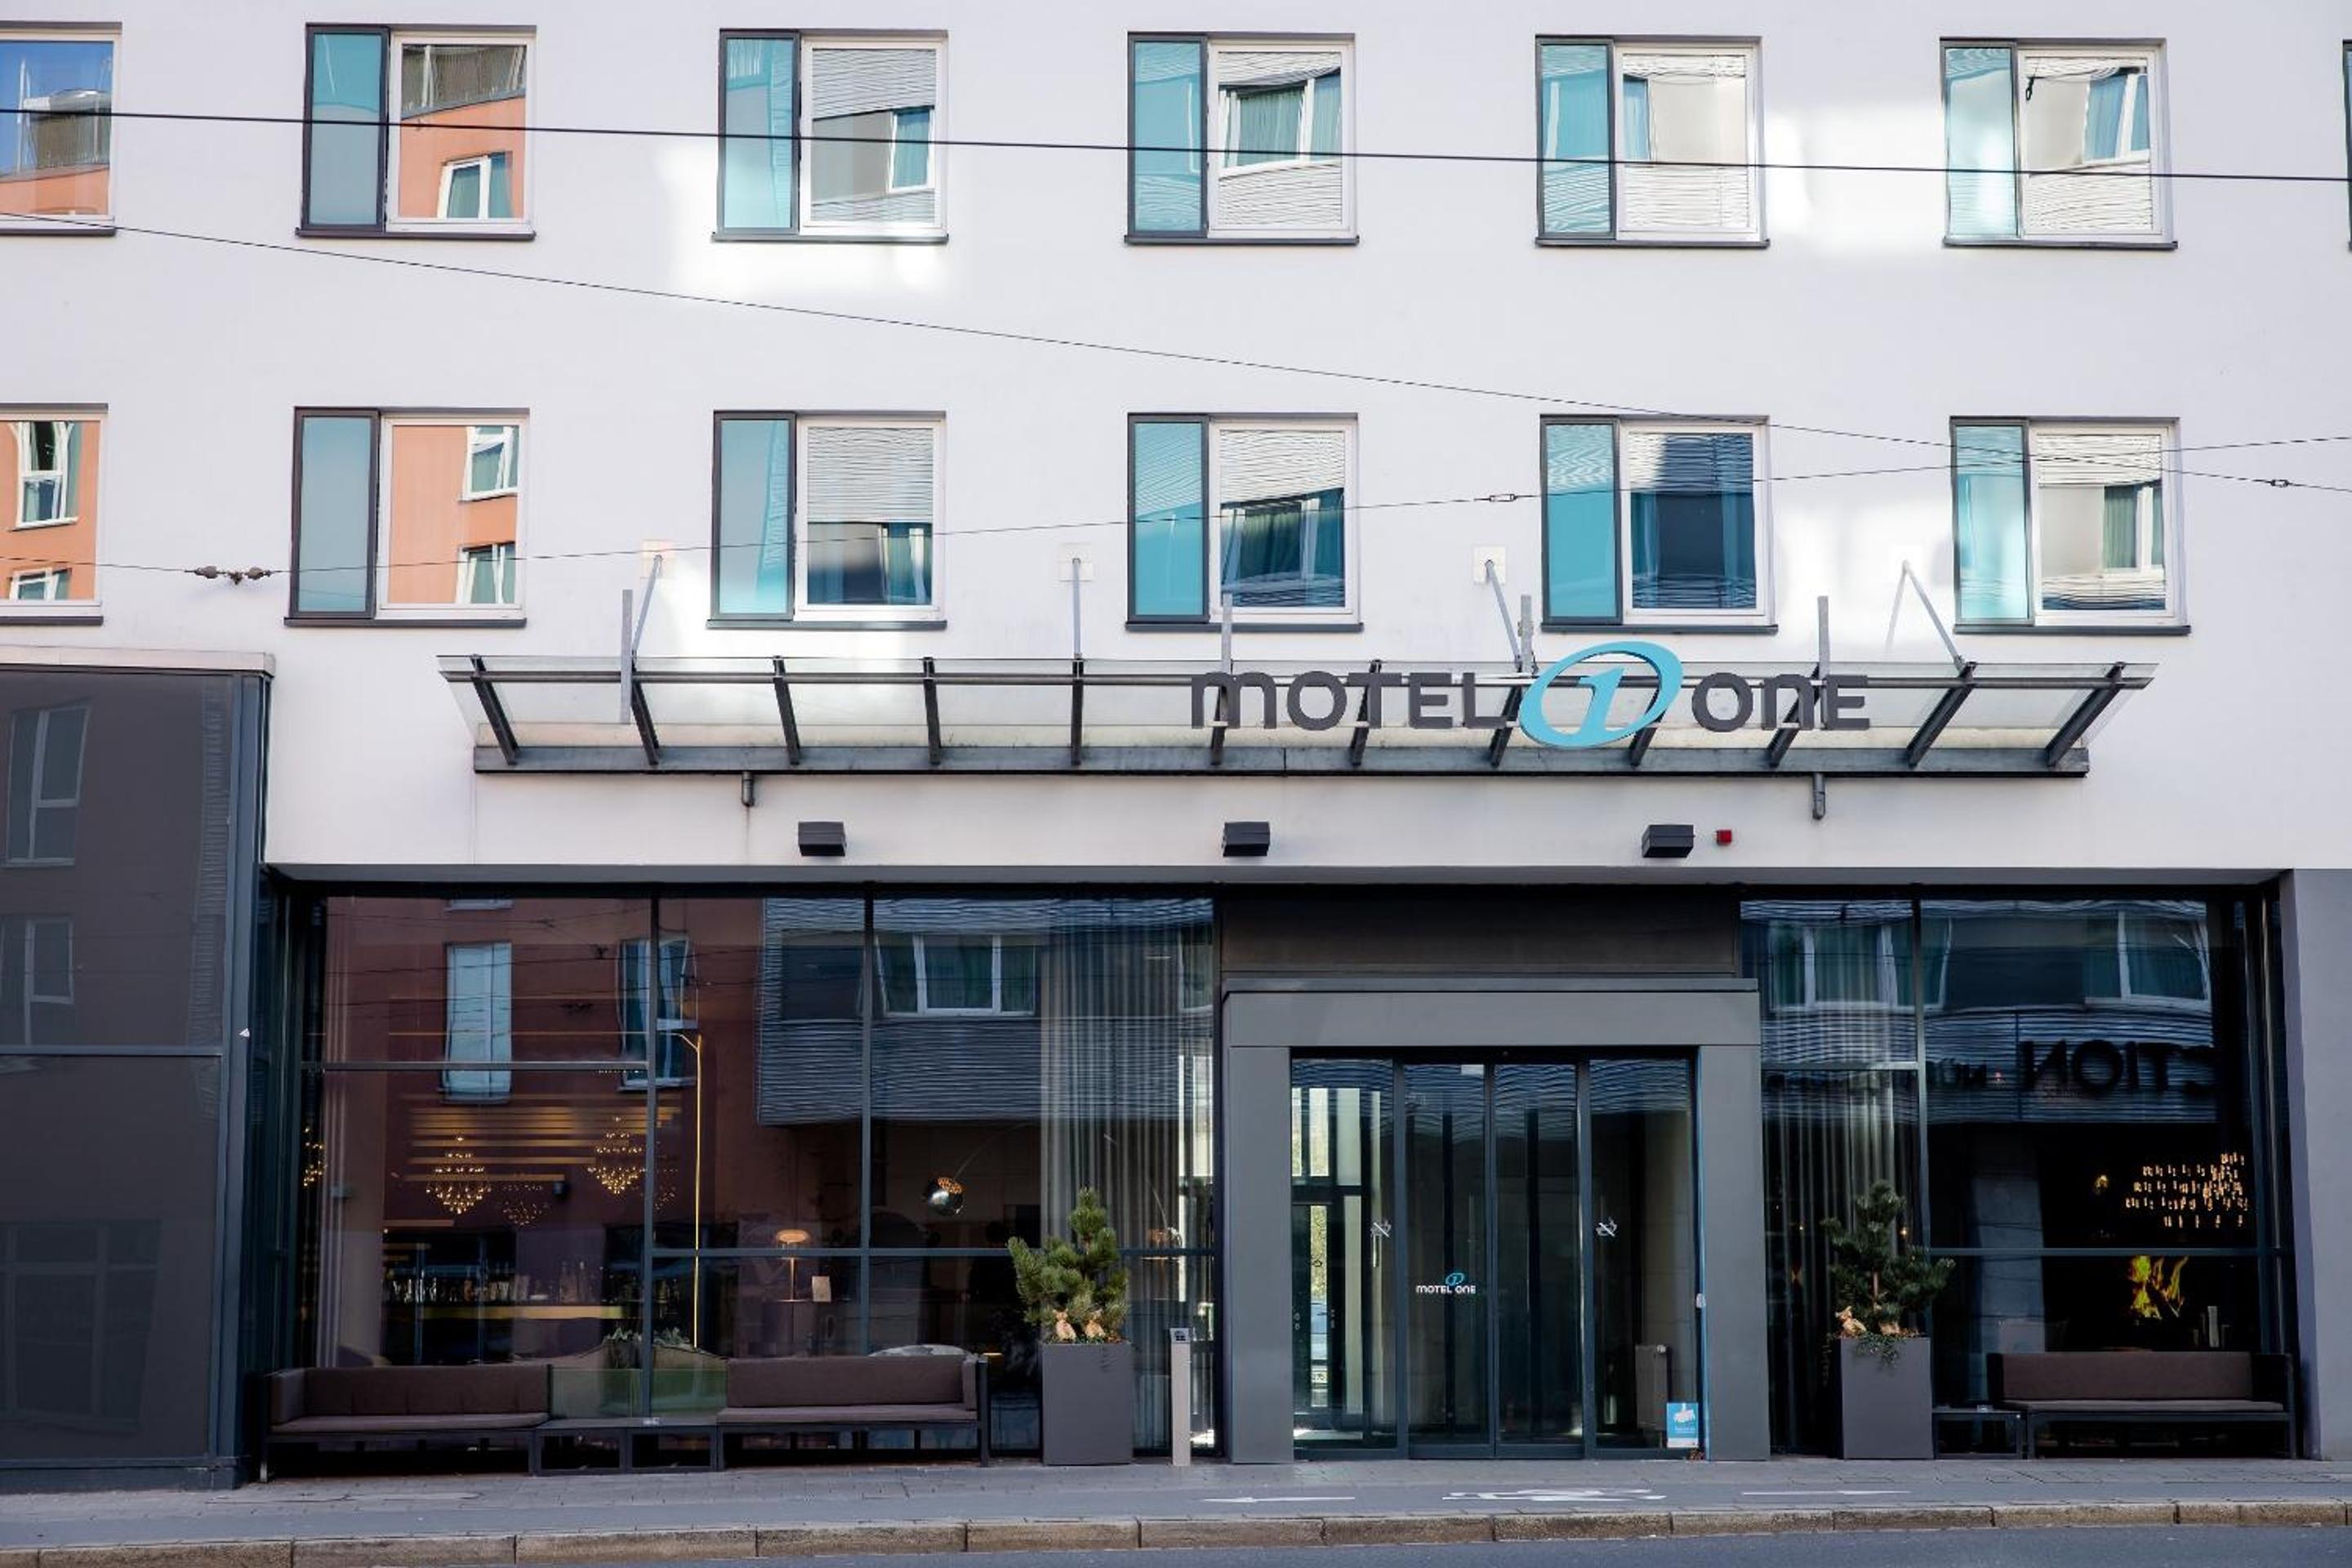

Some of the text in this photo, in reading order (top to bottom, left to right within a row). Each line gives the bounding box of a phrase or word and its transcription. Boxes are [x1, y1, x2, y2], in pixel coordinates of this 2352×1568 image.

[1191, 670, 1508, 730] MOTEL
[1691, 672, 1870, 732] ONE
[1415, 1285, 1477, 1294] MOTEL ONE
